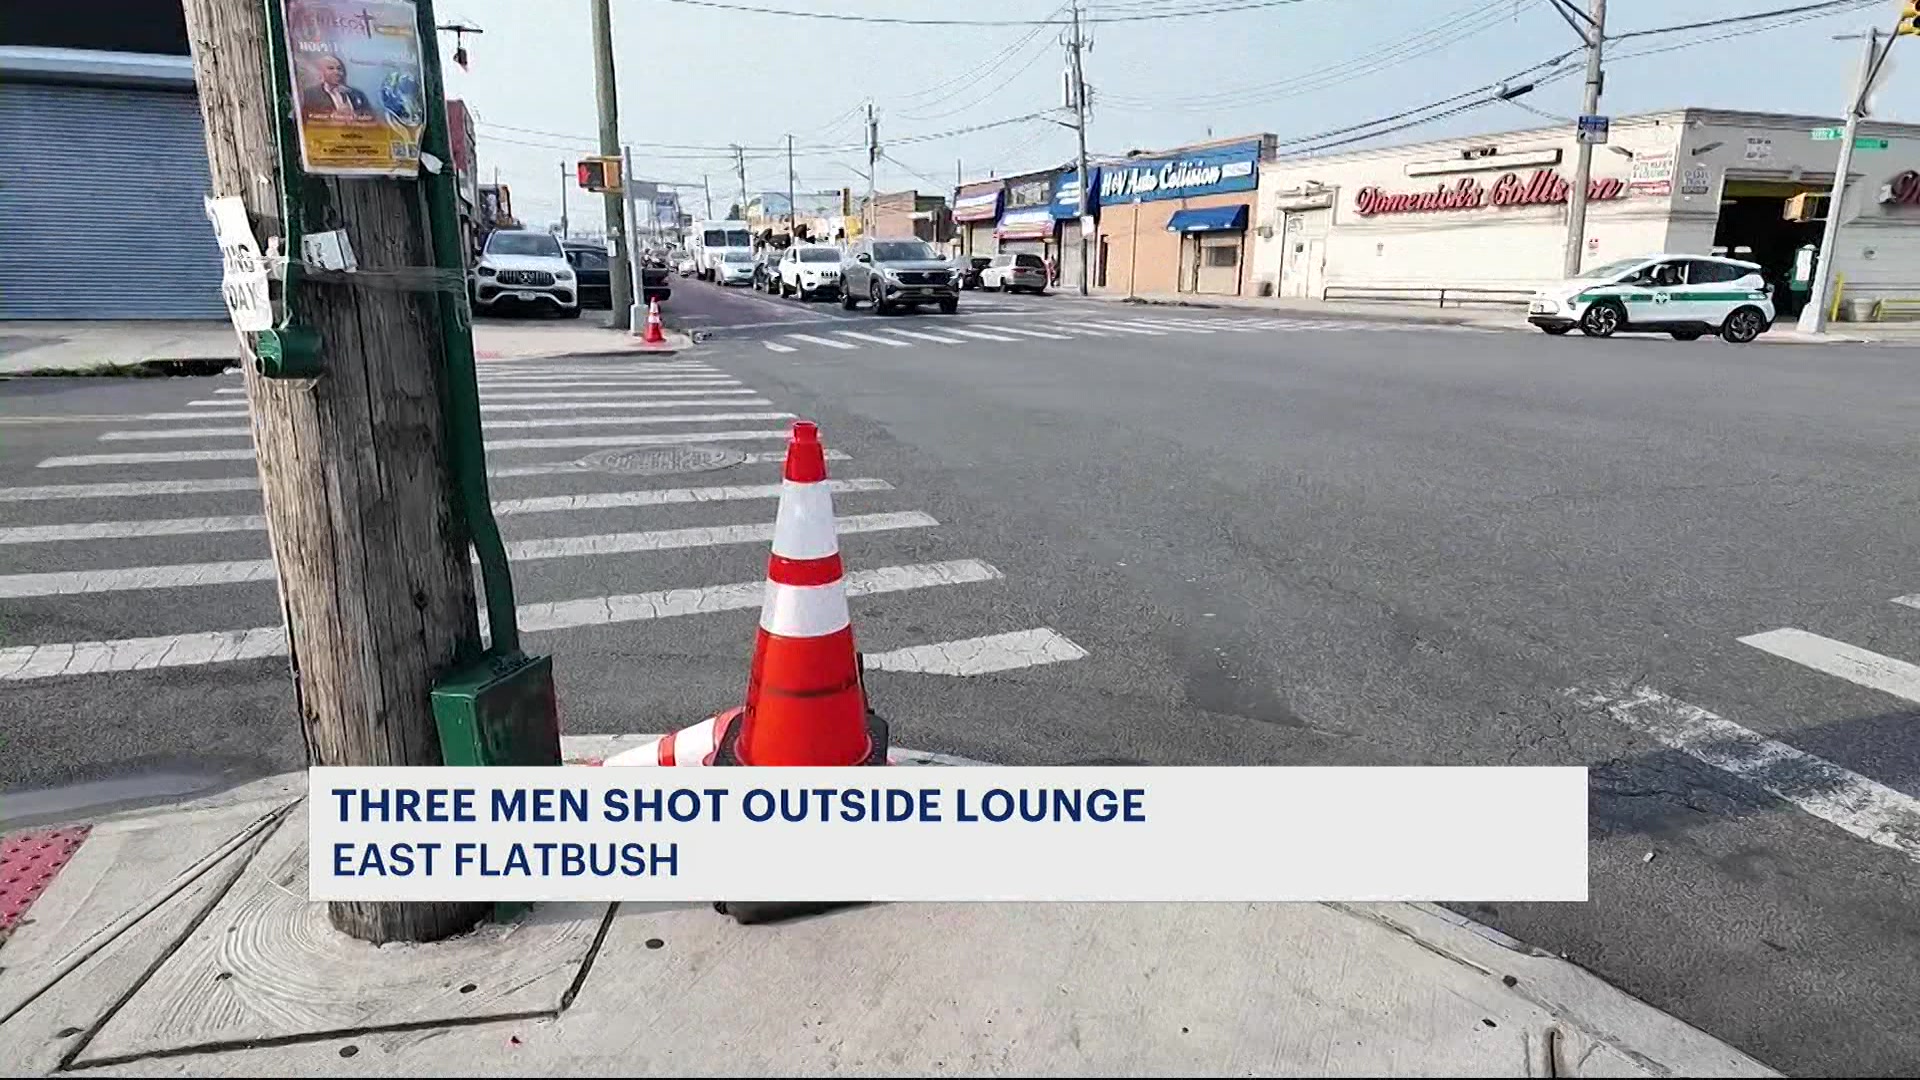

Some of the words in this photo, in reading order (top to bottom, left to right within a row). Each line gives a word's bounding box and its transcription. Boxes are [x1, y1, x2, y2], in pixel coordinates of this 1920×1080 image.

[1127, 168, 1158, 195] Auto
[1159, 161, 1221, 190] Collision
[1489, 169, 1624, 206] Collison
